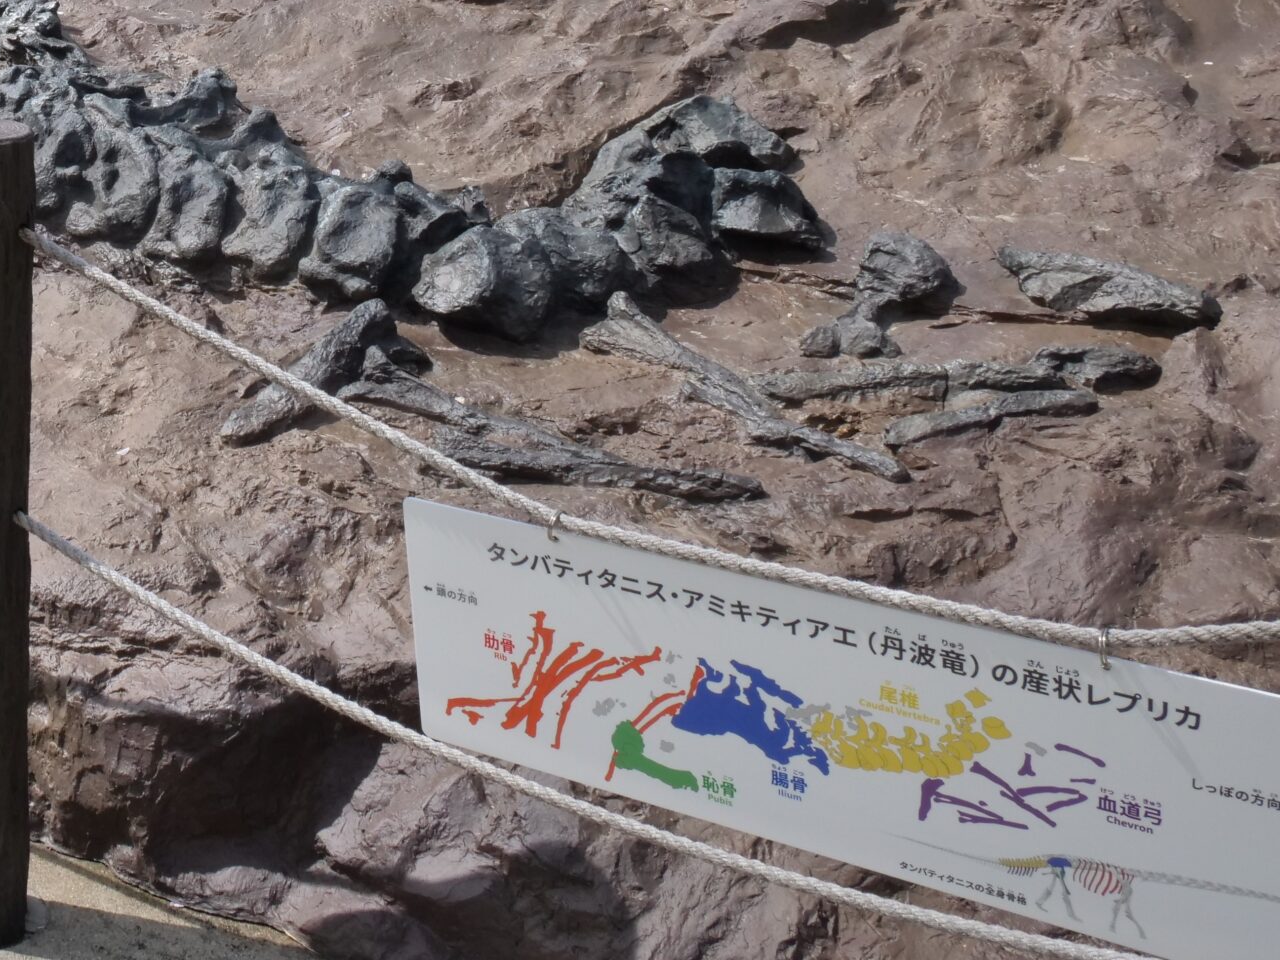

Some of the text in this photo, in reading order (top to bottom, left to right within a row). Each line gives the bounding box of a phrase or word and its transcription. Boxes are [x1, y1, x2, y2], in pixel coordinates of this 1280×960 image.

[436, 586, 478, 606] 頭の方向
[484, 633, 515, 654] 肋骨
[494, 652, 507, 661] Rib
[880, 685, 919, 710] 尾椎
[859, 698, 940, 725] Caudal Vertebra
[702, 775, 737, 798] 恥骨
[771, 770, 807, 793] 腸骨
[708, 793, 733, 807] Pubis
[778, 789, 802, 802] Ilium
[1192, 778, 1280, 811] しっぽの方向
[1096, 795, 1163, 826] 血道弓
[1106, 815, 1154, 834] Chevron
